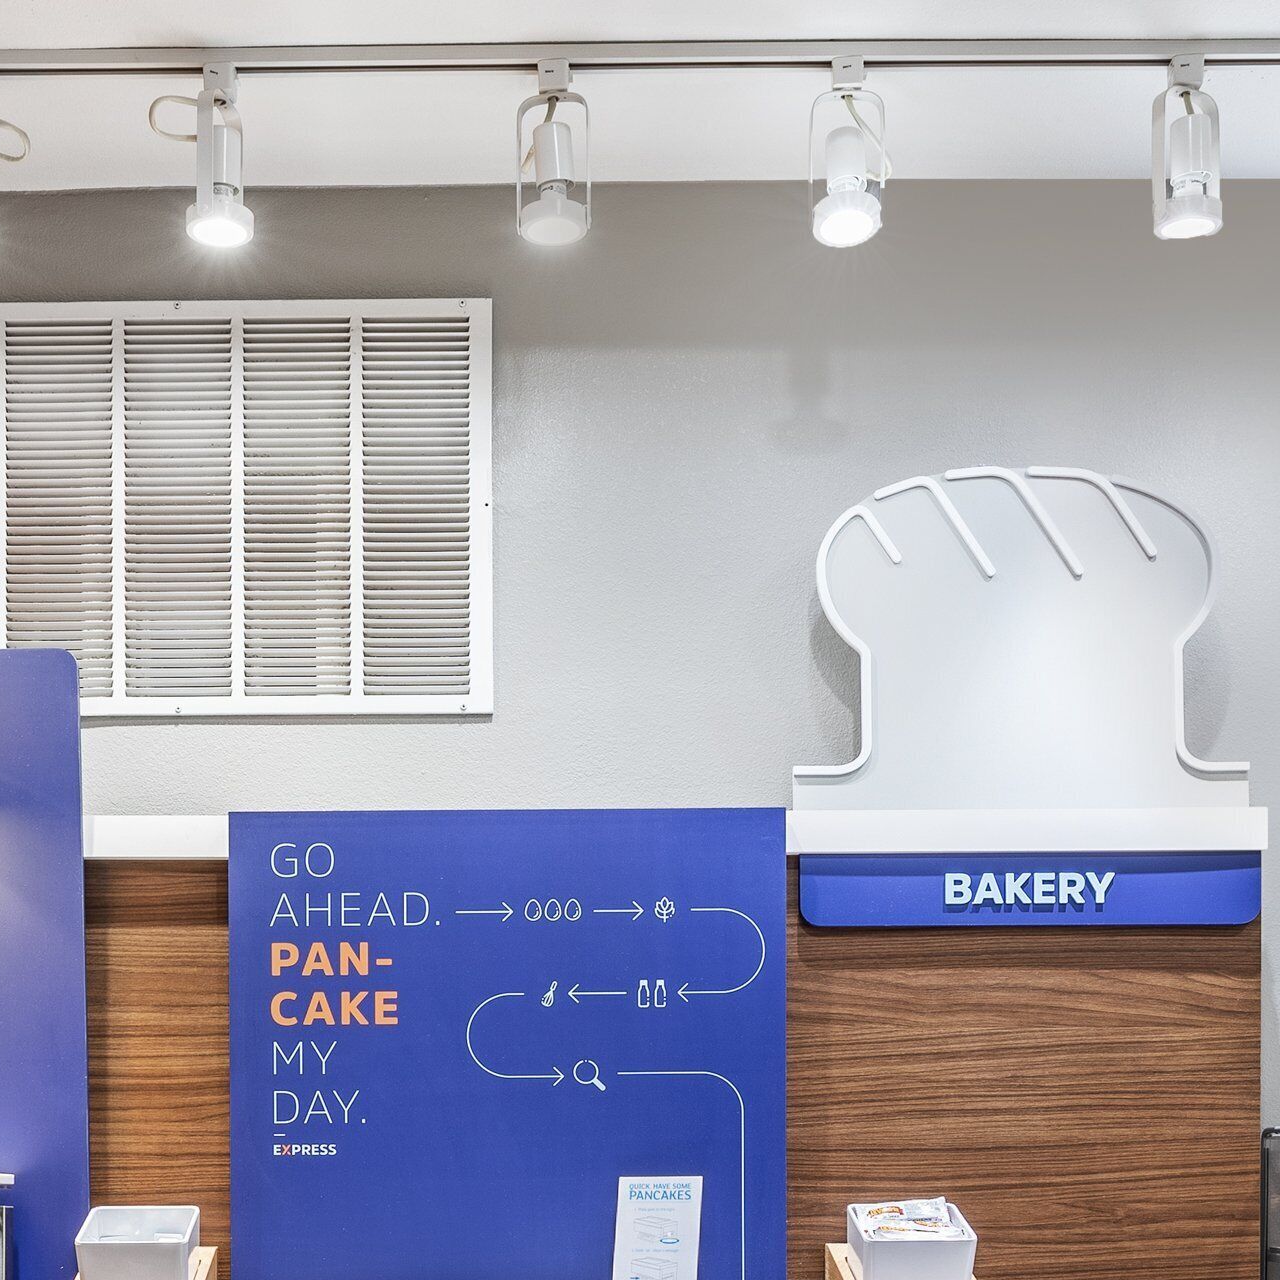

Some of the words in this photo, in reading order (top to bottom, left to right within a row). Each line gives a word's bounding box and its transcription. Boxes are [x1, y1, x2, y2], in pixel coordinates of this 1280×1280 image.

[270, 842, 336, 879] GO
[944, 871, 1116, 905] BAKERY
[269, 892, 441, 928] AHEAD.
[270, 941, 393, 977] PAN-
[270, 990, 399, 1026] CAKE
[272, 1040, 338, 1075] MY
[272, 1089, 367, 1125] DAY.
[273, 1143, 337, 1157] EXPRESS
[629, 1190, 692, 1200] PANCAKES
